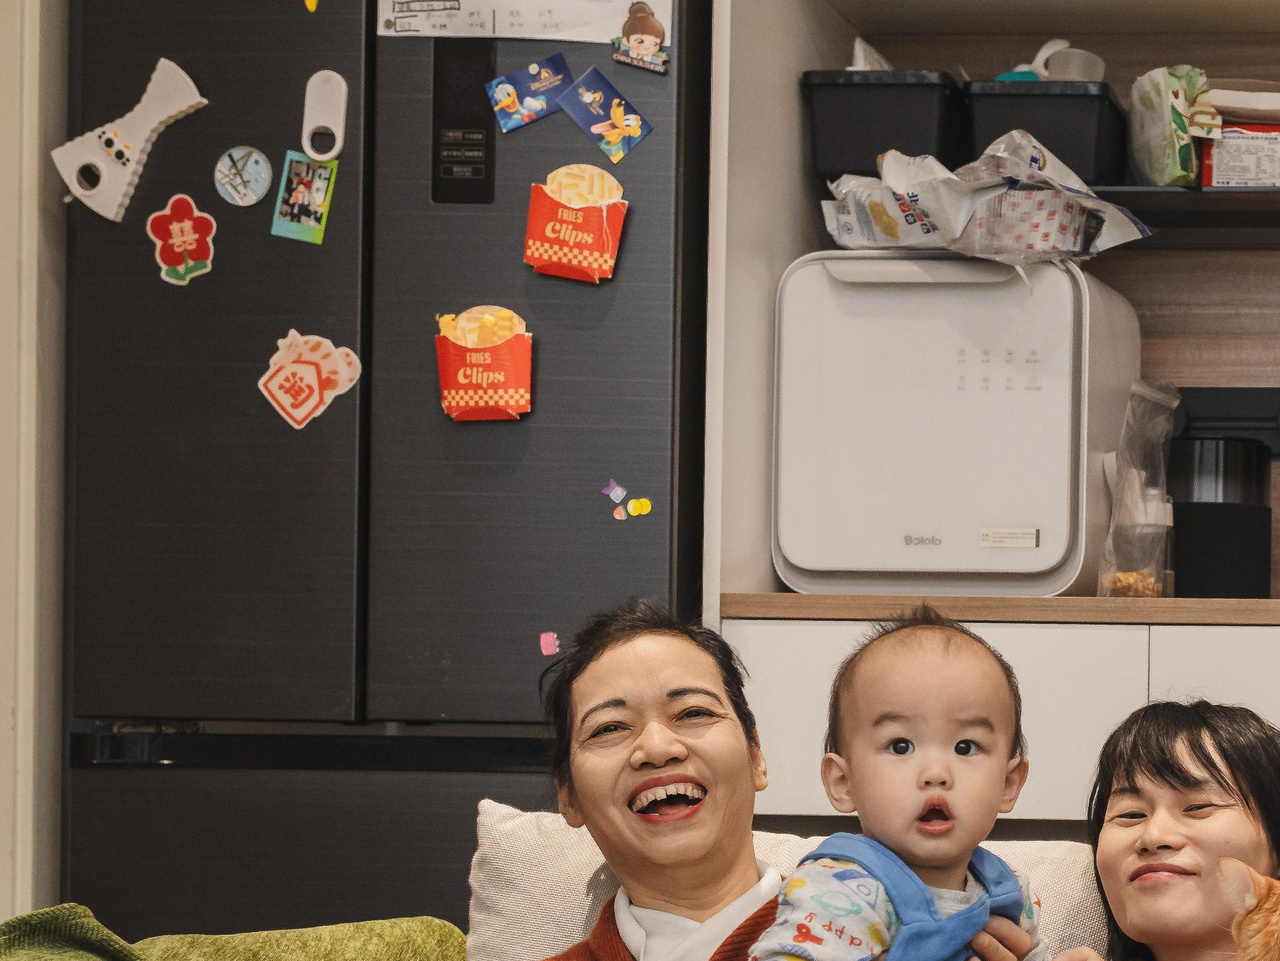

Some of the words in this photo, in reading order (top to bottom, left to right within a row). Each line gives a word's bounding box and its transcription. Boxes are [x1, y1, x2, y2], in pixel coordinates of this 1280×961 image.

[557, 207, 584, 223] FRIES
[544, 221, 595, 247] Clips
[466, 351, 492, 365] FRIES
[457, 366, 505, 388] Clips
